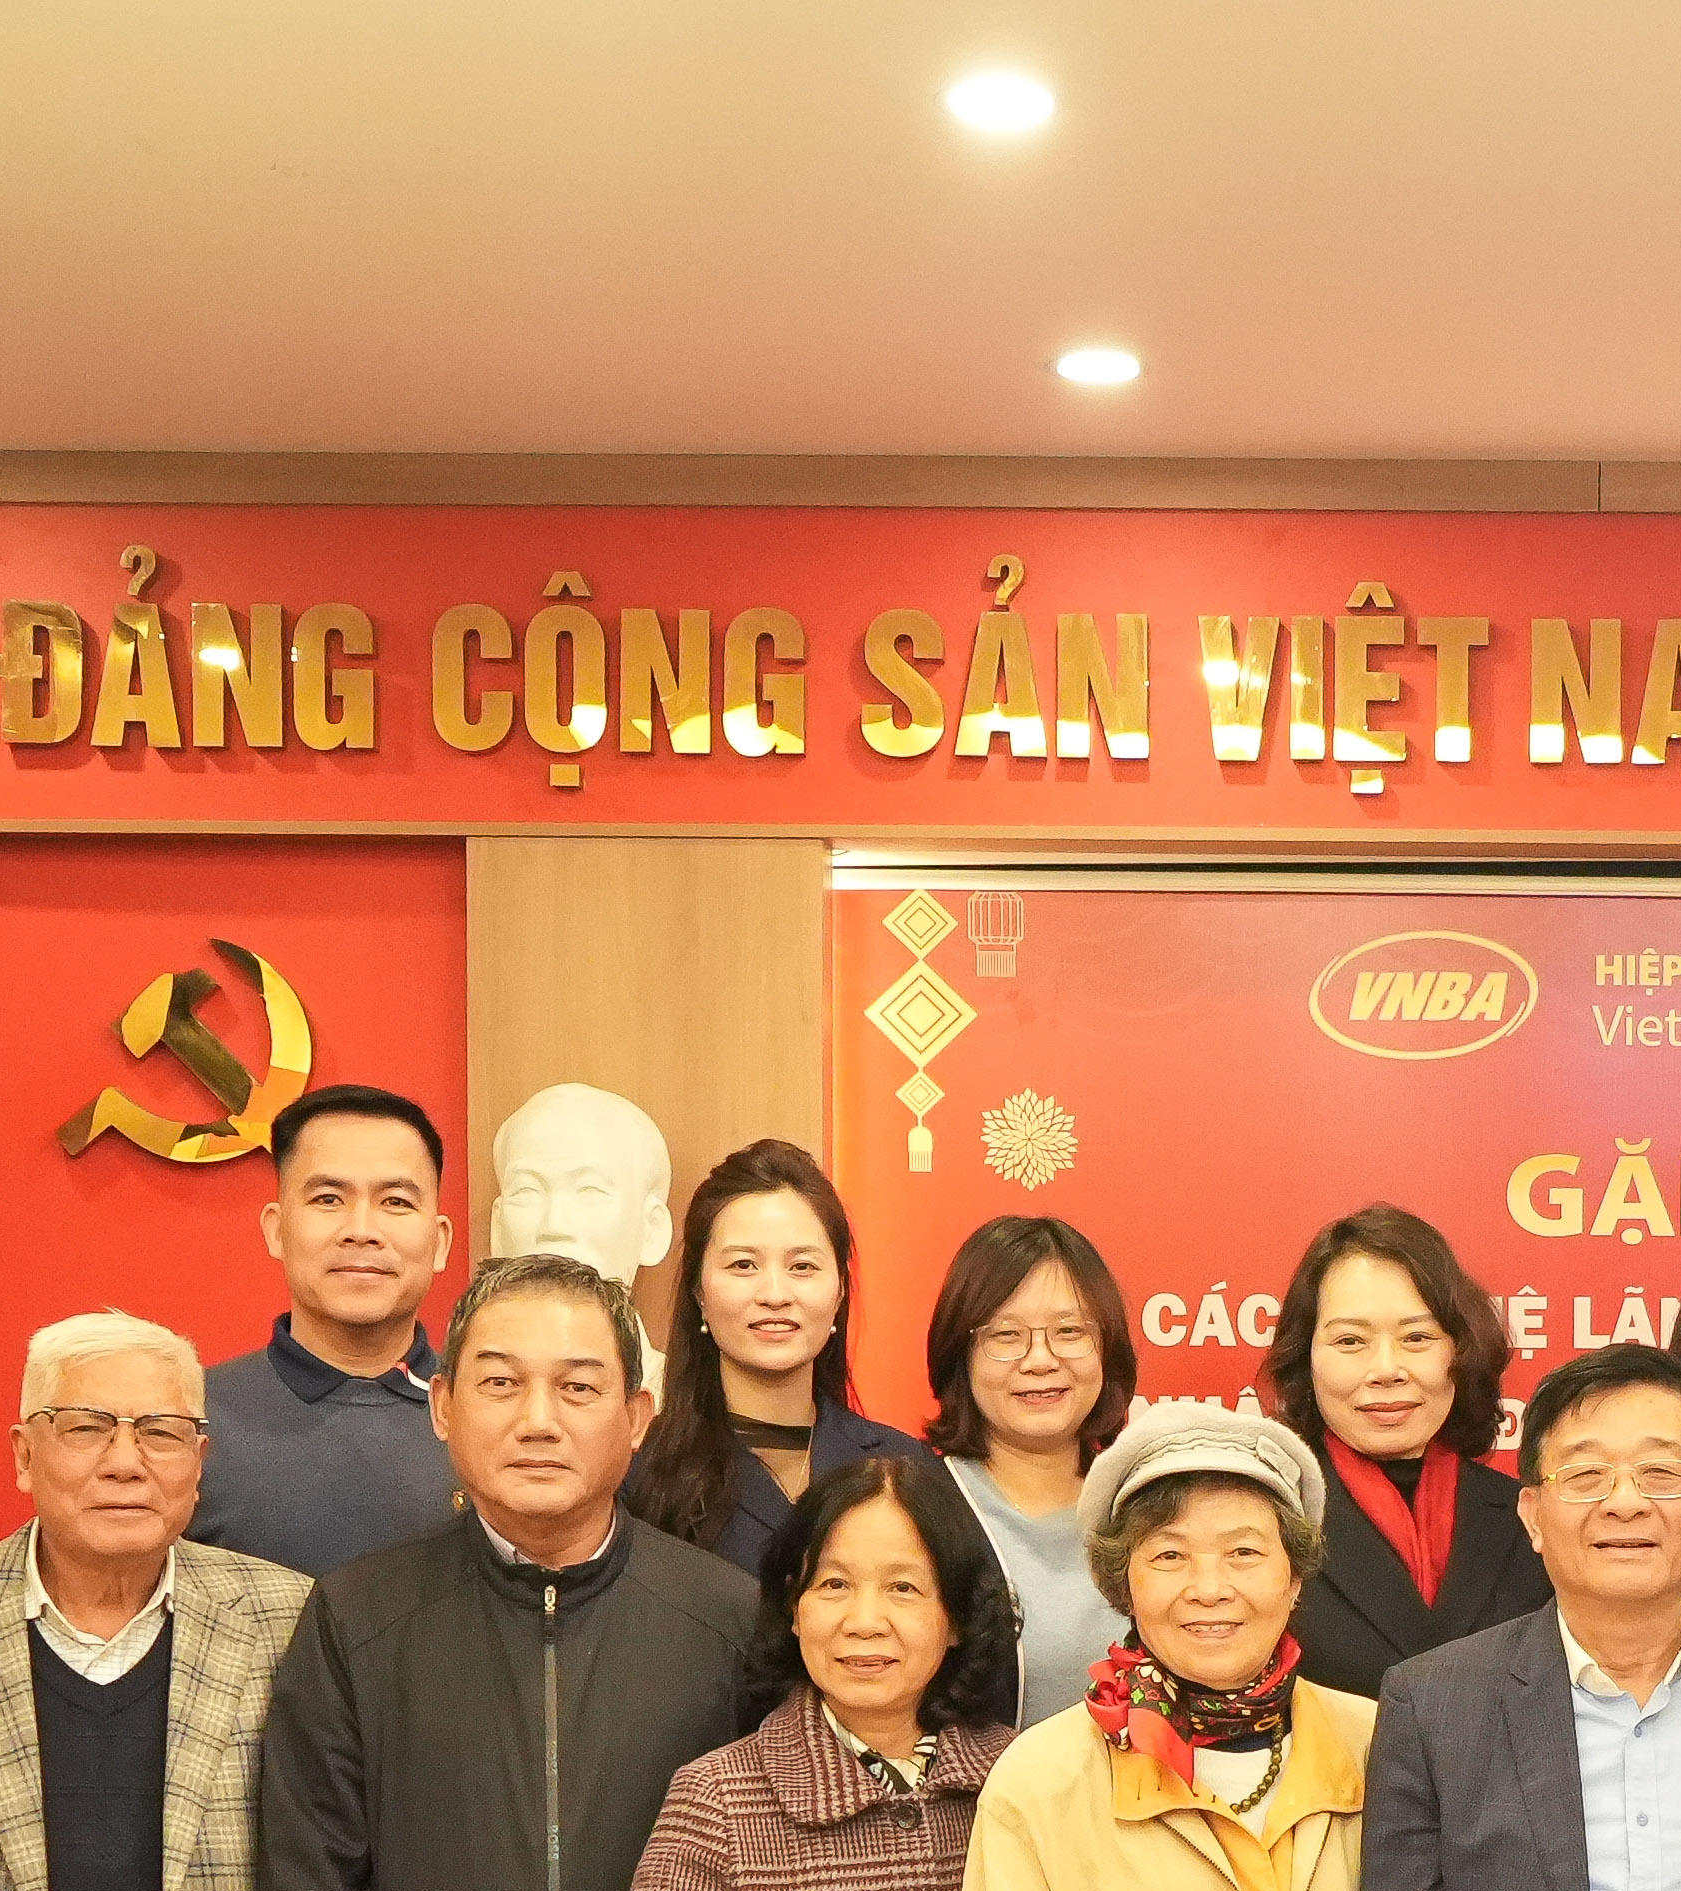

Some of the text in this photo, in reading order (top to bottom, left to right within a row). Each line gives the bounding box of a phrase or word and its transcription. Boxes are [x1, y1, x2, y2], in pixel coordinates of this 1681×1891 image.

[431, 570, 808, 788] CỘNG
[860, 553, 1154, 764] SẢN
[1198, 581, 1491, 796] VIỆT
[1347, 971, 1510, 1023] VNBA
[1141, 1281, 1282, 1347] CÁC
